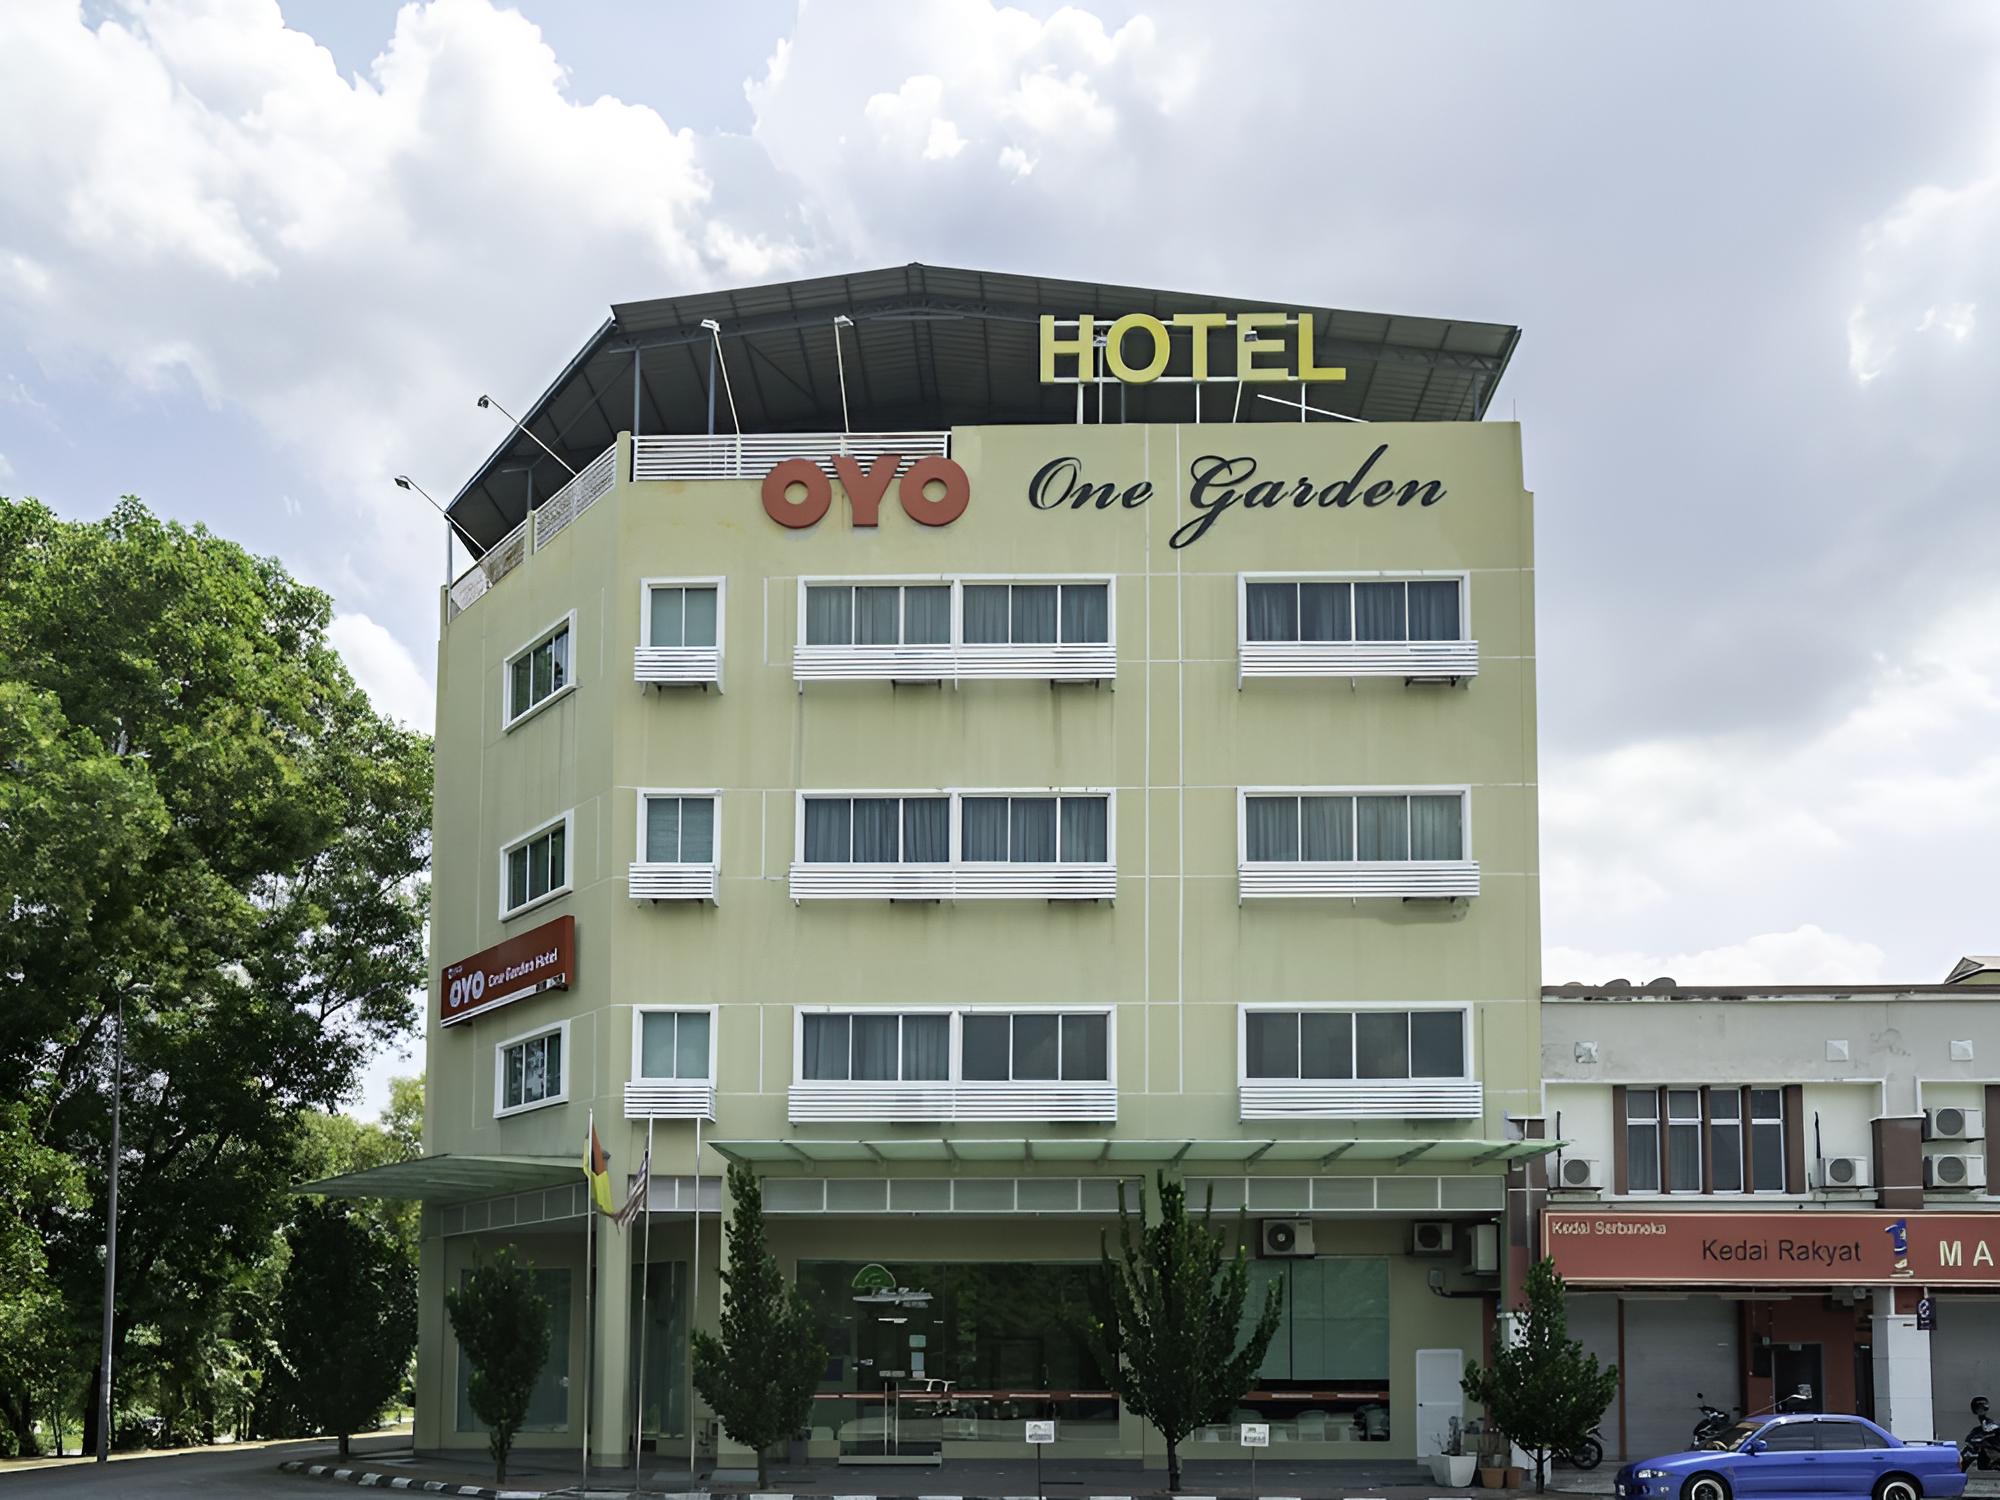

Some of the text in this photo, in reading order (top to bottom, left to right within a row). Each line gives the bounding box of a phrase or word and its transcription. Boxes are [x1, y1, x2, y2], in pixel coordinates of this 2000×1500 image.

[1039, 312, 1346, 384] HOTEL
[761, 454, 970, 528] OYO
[1028, 443, 1447, 549] One Garden
[449, 970, 485, 1008] OYO
[535, 947, 558, 969] Hotel
[1552, 1221, 1590, 1235] Kedai
[1702, 1238, 1768, 1262] Kedai
[1779, 1238, 1863, 1267] Rakyat
